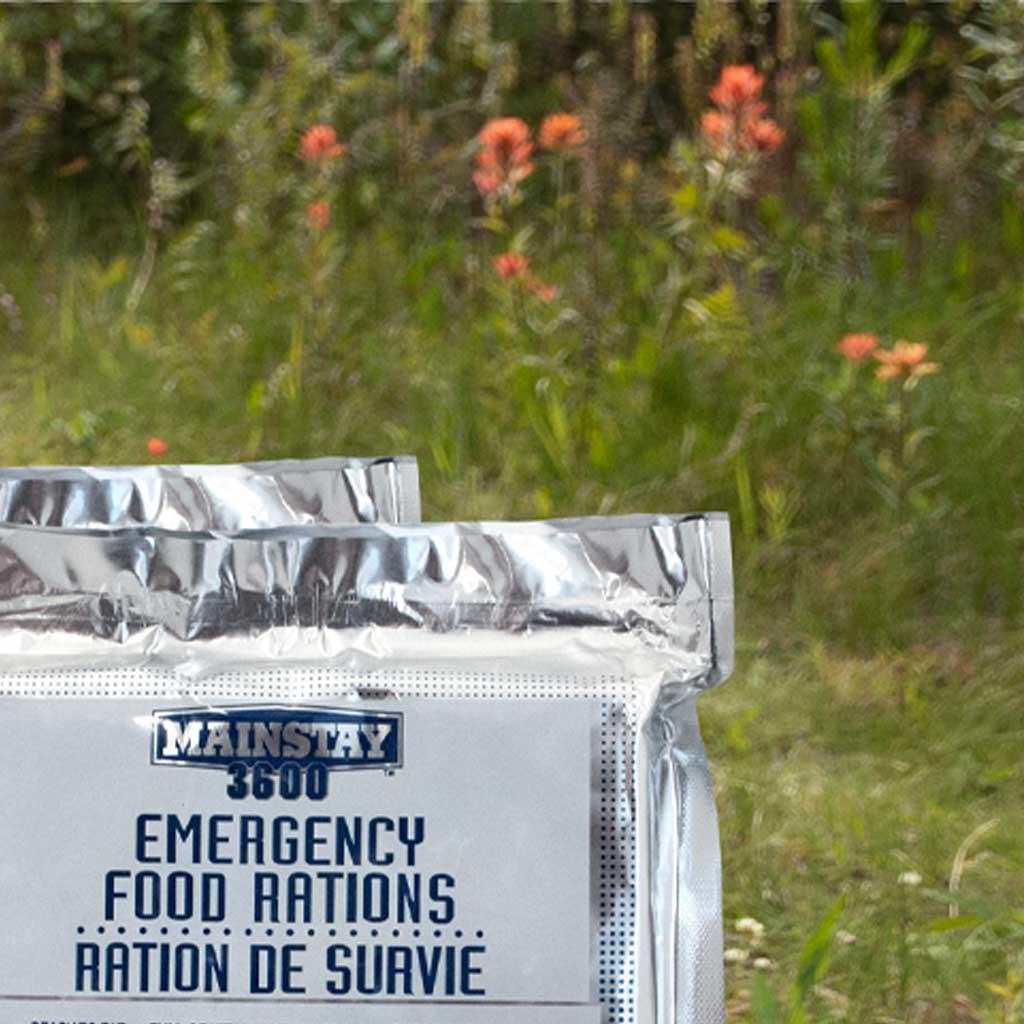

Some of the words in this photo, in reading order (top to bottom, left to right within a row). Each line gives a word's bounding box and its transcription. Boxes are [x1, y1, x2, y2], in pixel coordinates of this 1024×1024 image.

[161, 719, 392, 760] MAINSTAY
[226, 761, 330, 800] 3600
[136, 814, 426, 866] EMERGENCY
[104, 871, 226, 922] FOOD
[254, 872, 456, 923] RATIONS
[75, 943, 230, 993] RATION
[250, 943, 307, 994] DE
[326, 944, 486, 995] SURVIE
